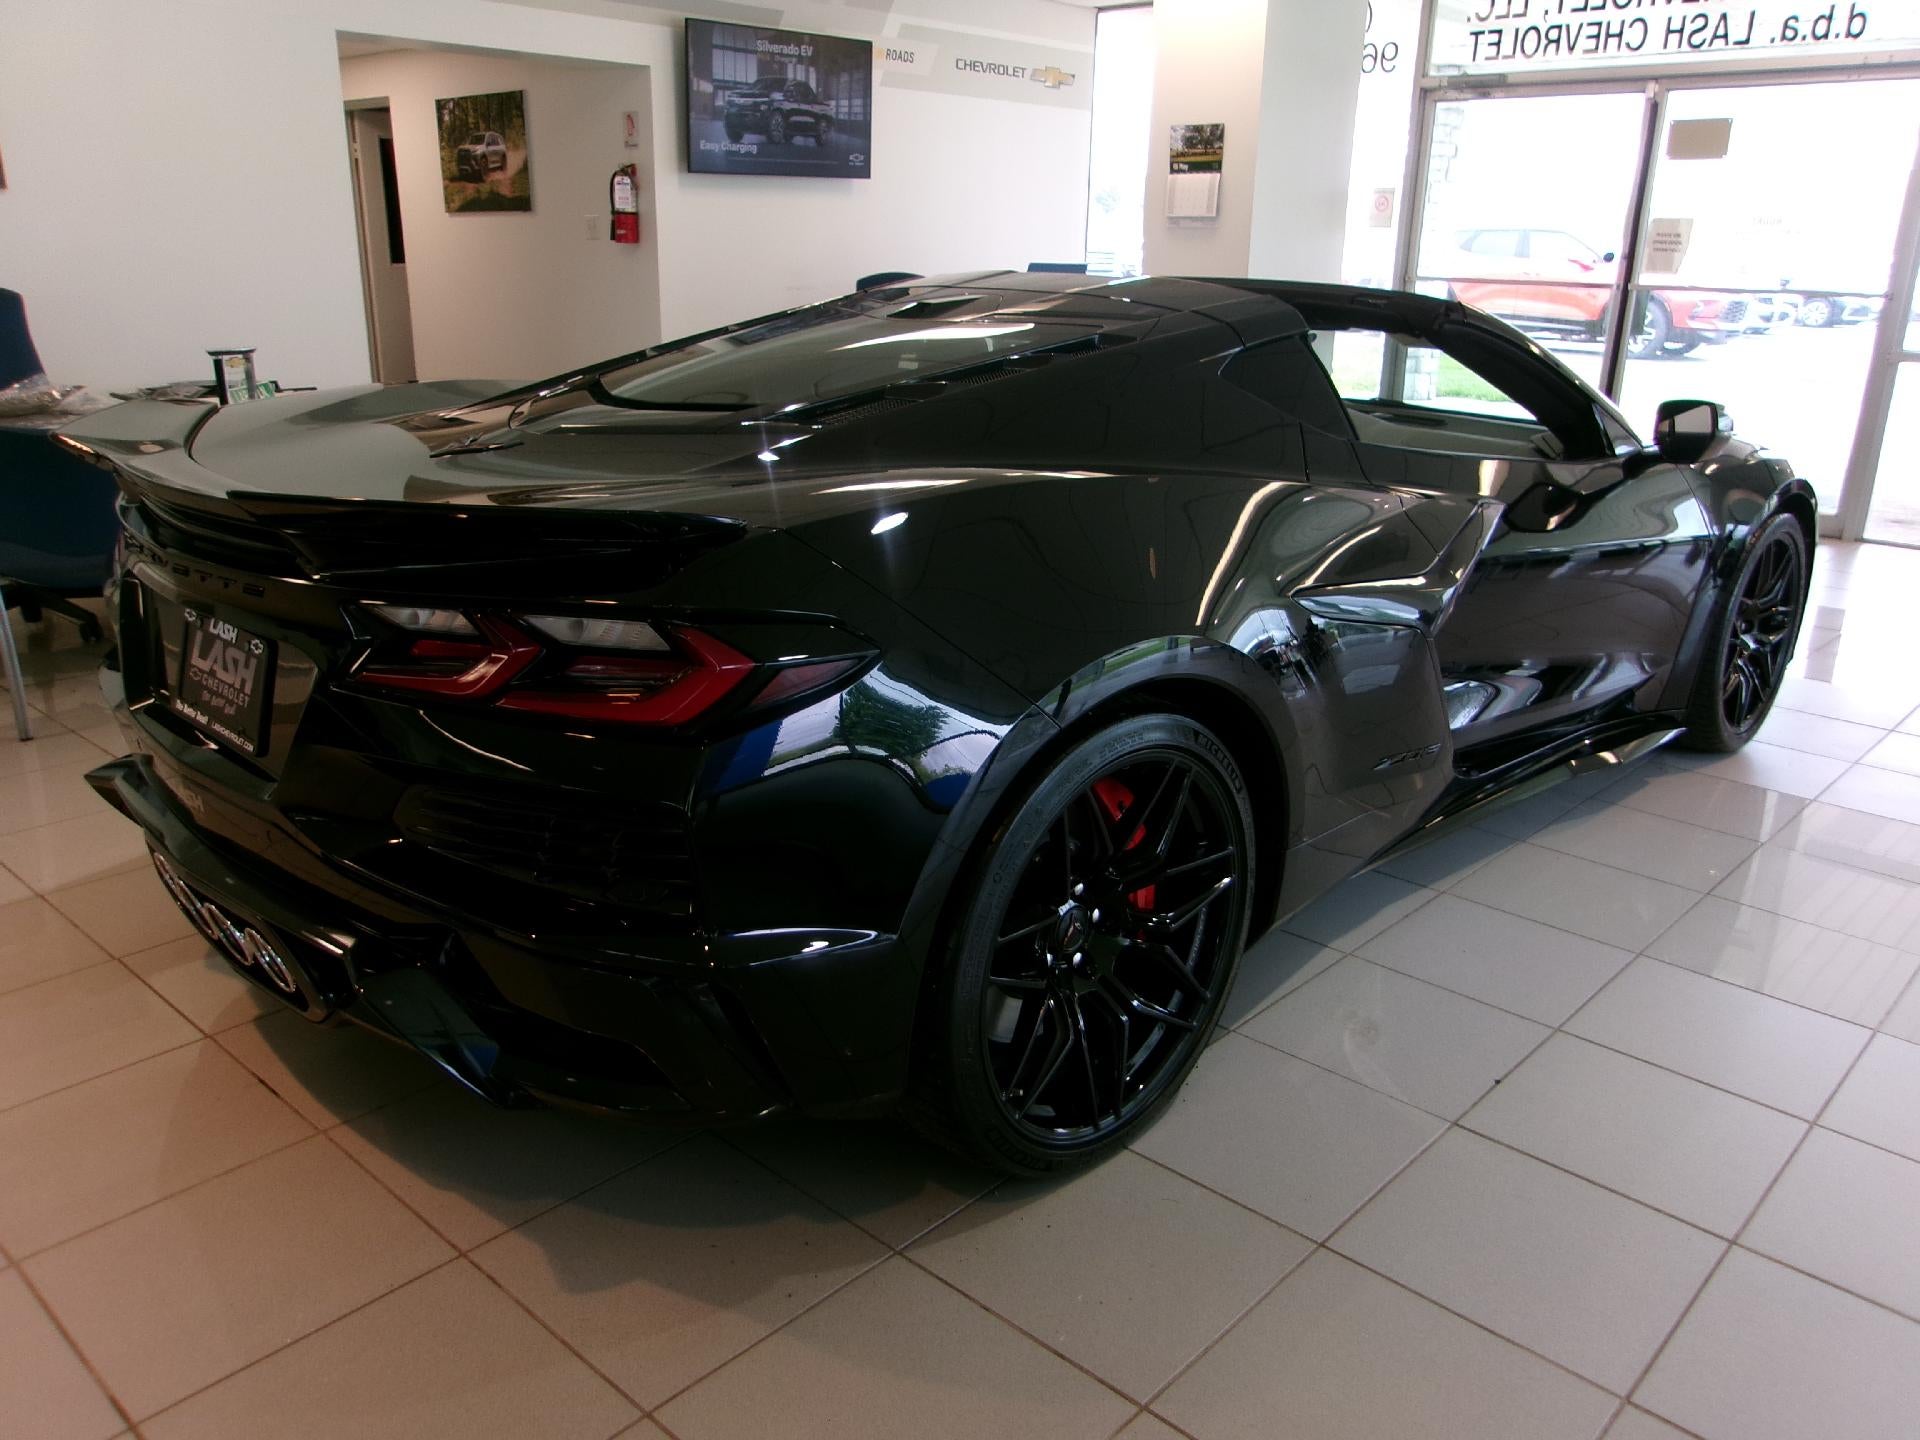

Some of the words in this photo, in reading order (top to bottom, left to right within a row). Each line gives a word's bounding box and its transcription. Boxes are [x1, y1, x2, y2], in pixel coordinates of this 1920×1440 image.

[755, 40, 800, 56] Silverado
[800, 44, 814, 57] EV
[885, 48, 915, 64] ROADS
[955, 57, 1027, 79] CHEVROLET
[700, 140, 720, 152] Easy
[721, 142, 758, 155] Charging
[209, 617, 239, 644] LASH
[191, 629, 257, 696] LASH
[201, 674, 249, 708] CHEVROLET
